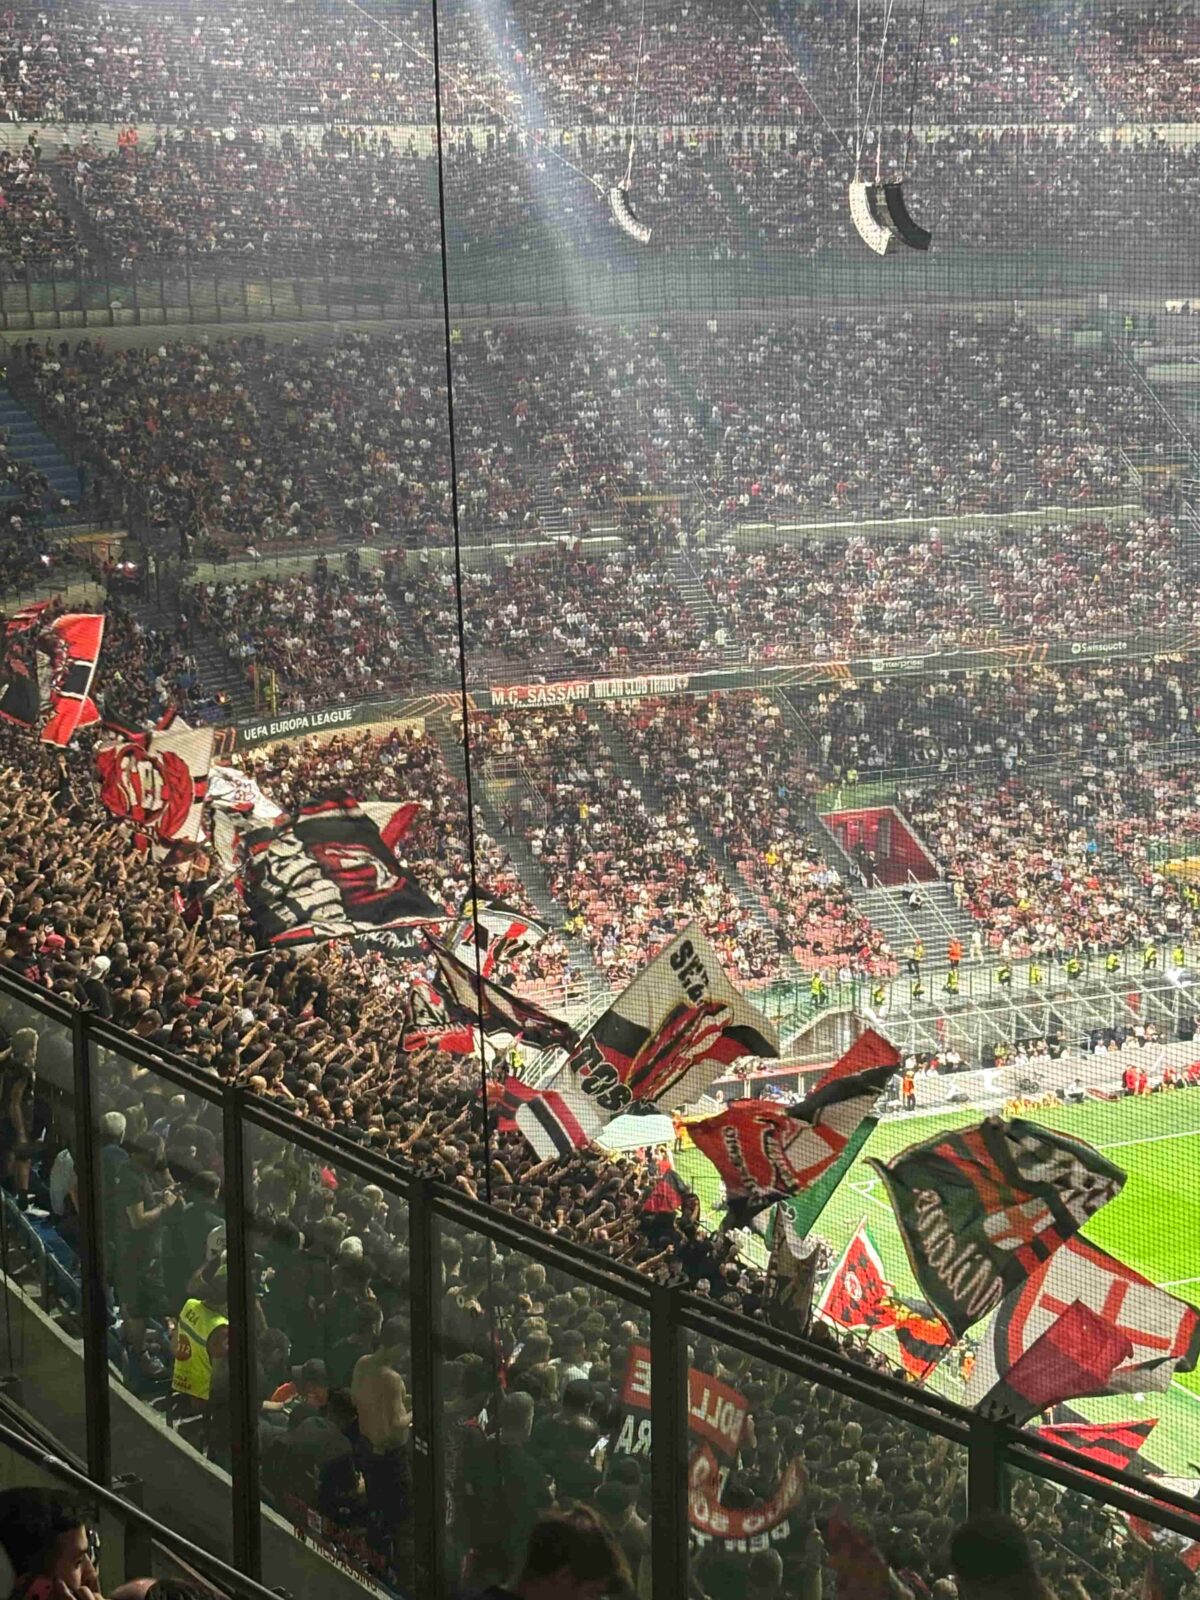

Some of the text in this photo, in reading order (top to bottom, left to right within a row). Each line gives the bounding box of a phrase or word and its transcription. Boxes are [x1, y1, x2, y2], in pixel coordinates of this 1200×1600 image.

[491, 687, 522, 706] M.C.
[527, 684, 590, 704] SASSARI
[593, 679, 623, 698] MILAN
[625, 677, 648, 695] CLUB
[243, 709, 353, 740] UEFA EUROPA LEAGUE
